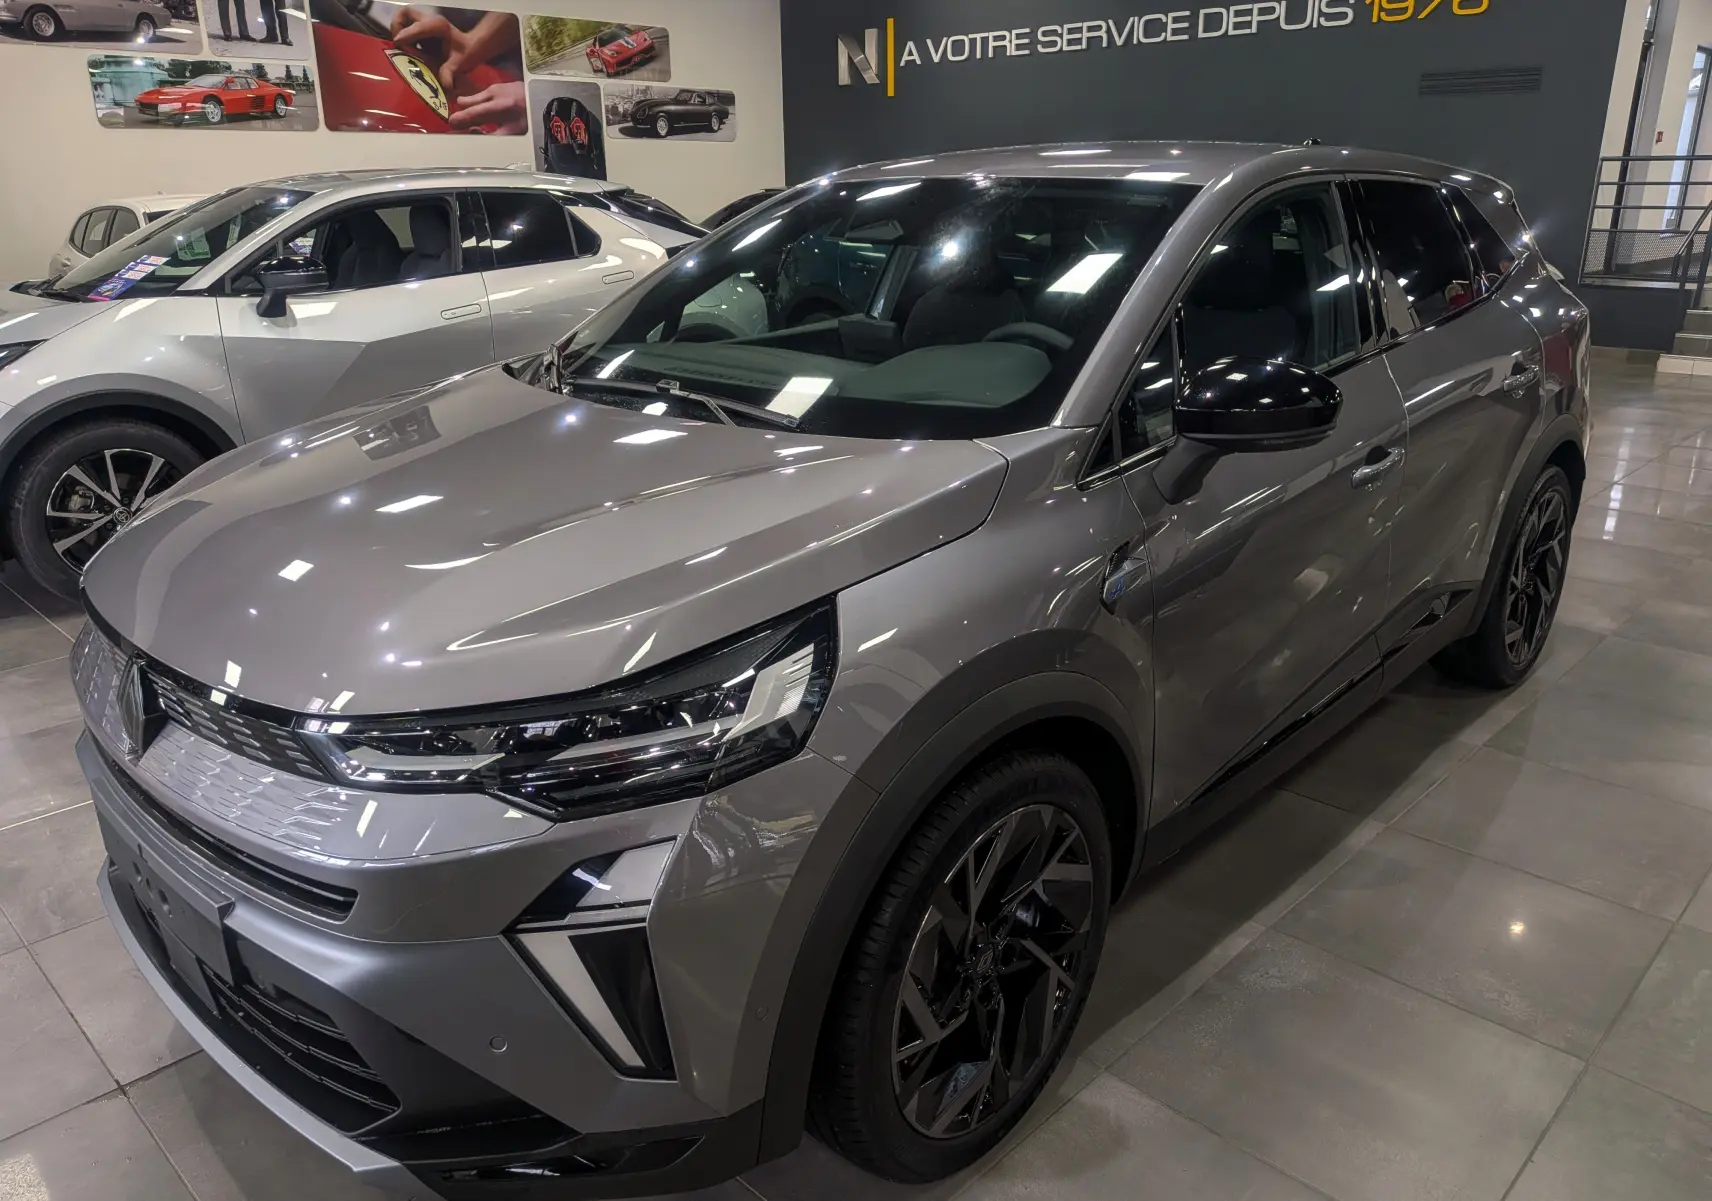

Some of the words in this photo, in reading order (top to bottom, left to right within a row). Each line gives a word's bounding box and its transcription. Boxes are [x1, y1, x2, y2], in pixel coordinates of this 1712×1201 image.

[900, 40, 922, 67] A
[926, 28, 1031, 63] VOTRE
[1037, 10, 1191, 53] SERVICE
[1198, 0, 1355, 39] DEPUIS
